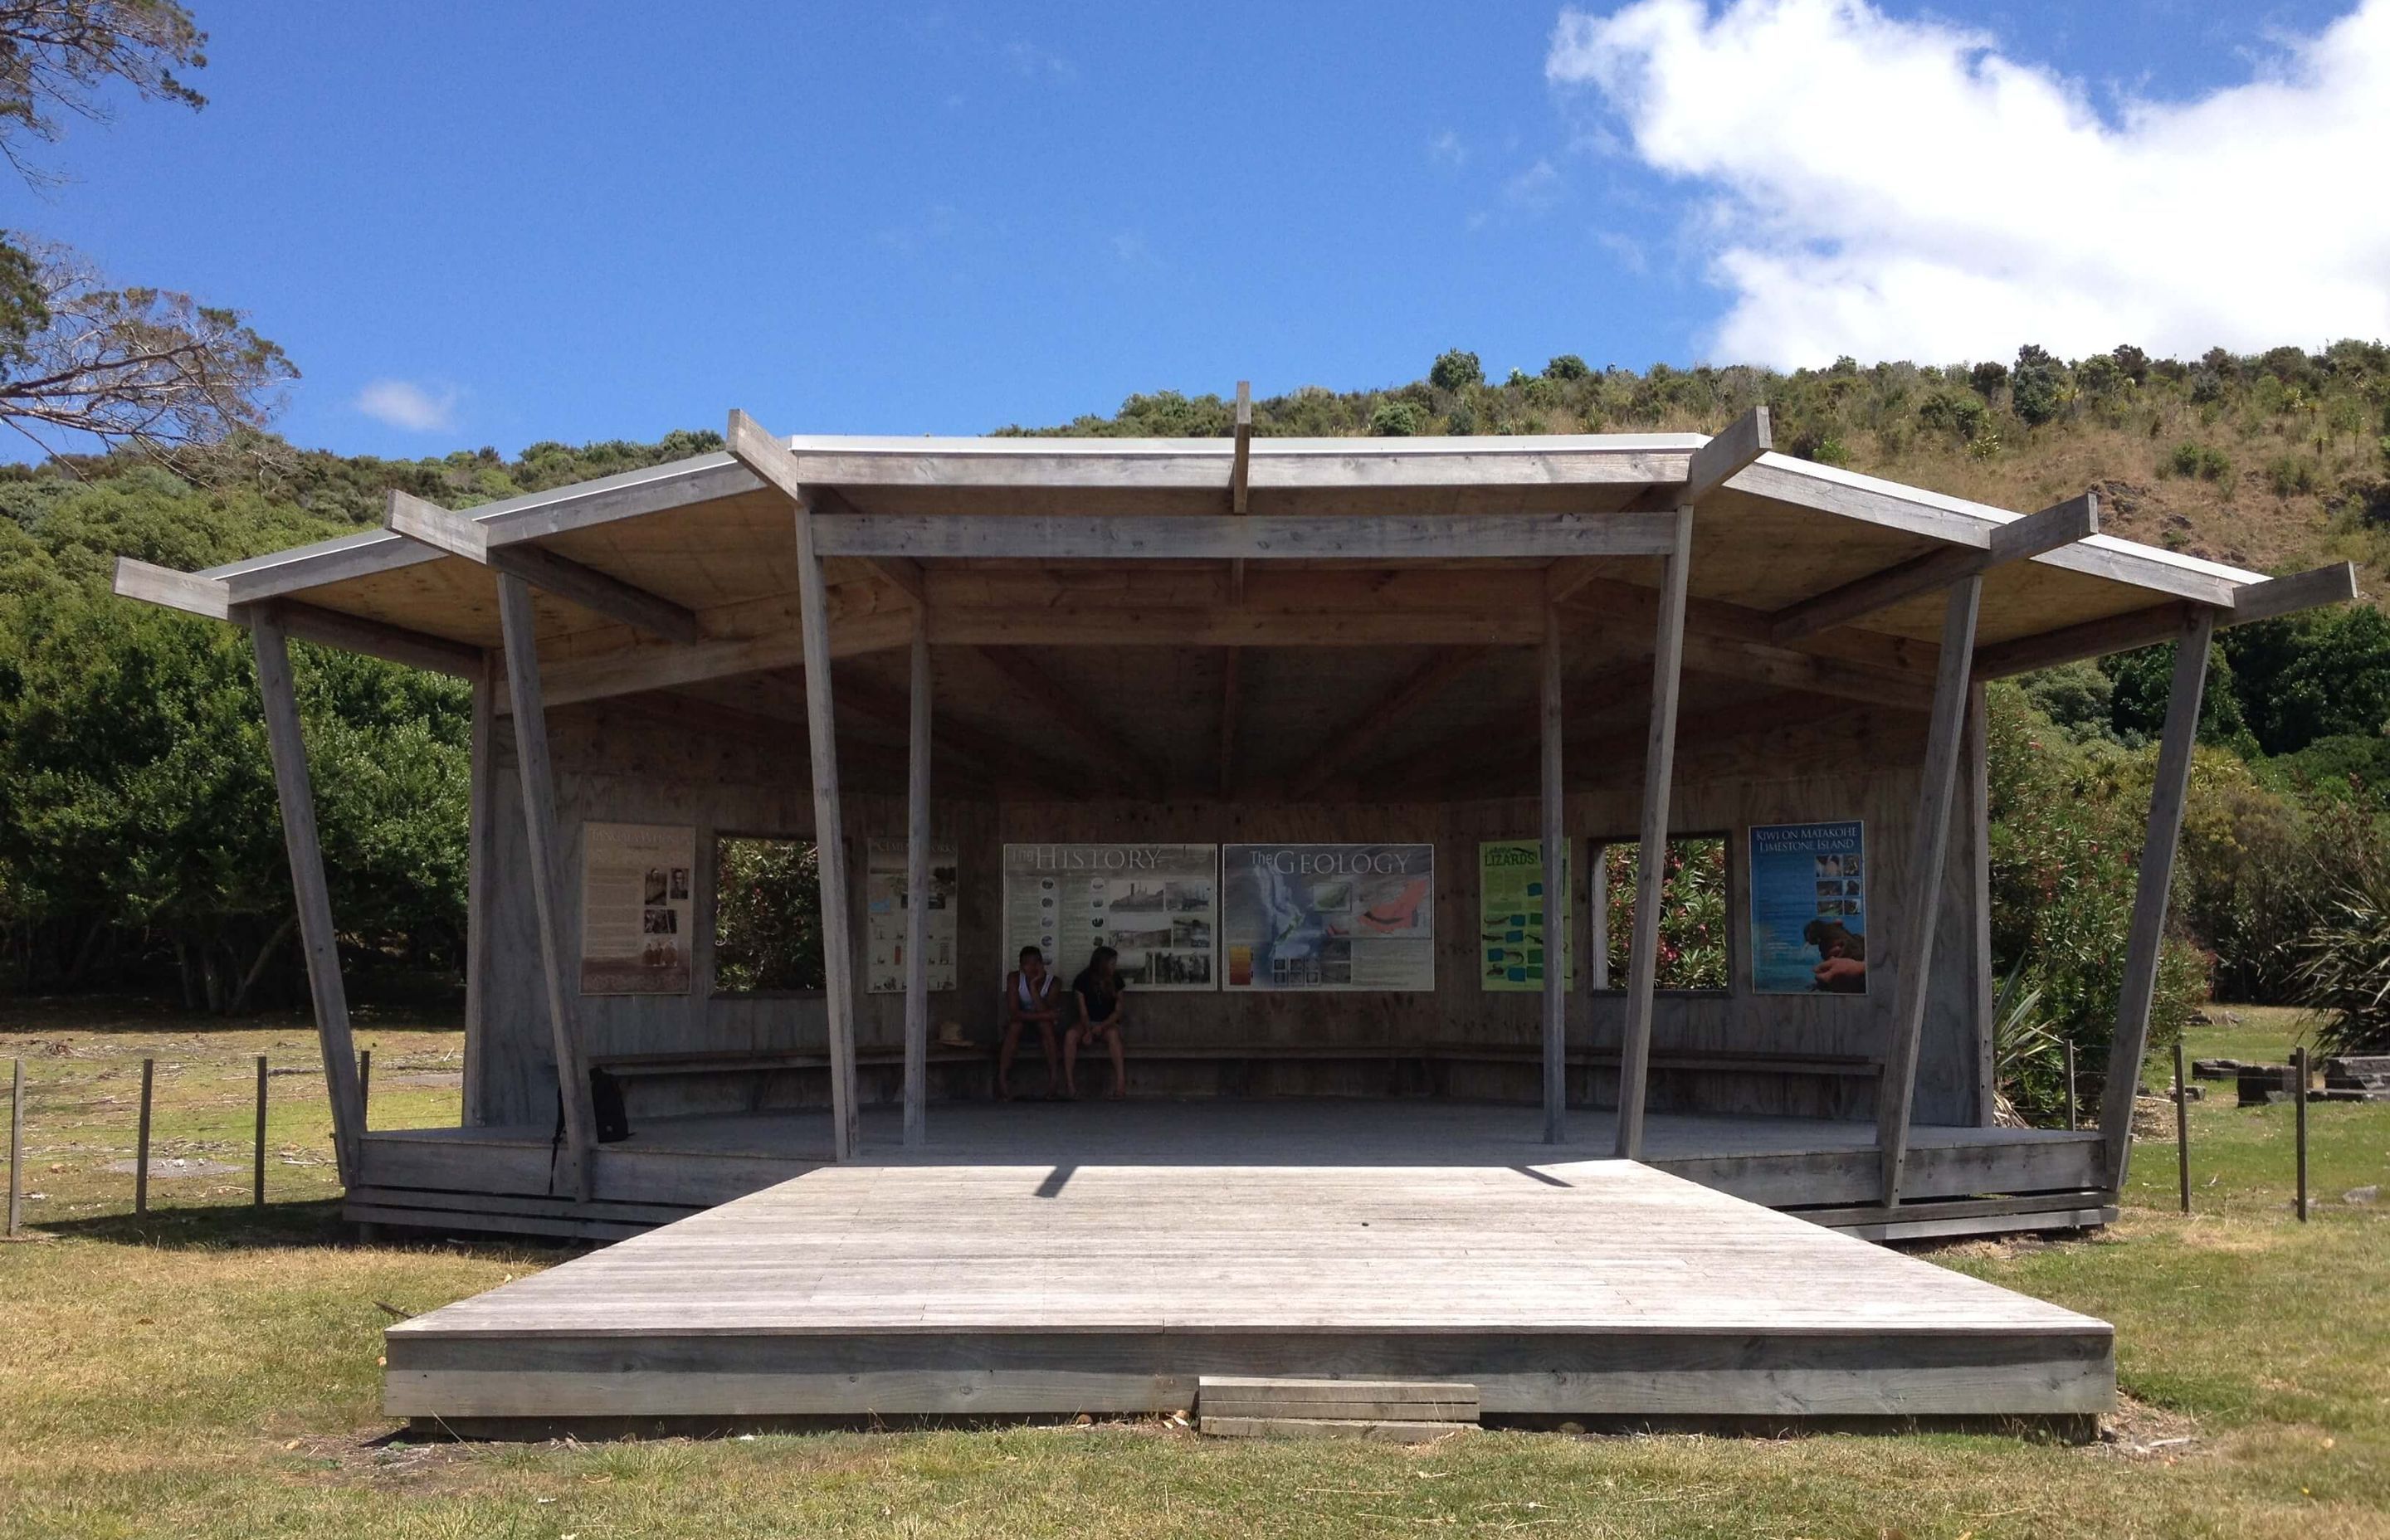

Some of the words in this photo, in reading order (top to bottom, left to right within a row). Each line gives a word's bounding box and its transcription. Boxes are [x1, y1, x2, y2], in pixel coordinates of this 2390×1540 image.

[1757, 830, 1780, 841] KIWI
[1782, 830, 1798, 840] ON
[1801, 827, 1858, 839] MATAKOHE
[1759, 841, 1815, 852] LIMESTONE
[1817, 839, 1855, 850] ISLAND
[1036, 846, 1161, 869] HISTORY
[1250, 850, 1273, 865] The
[1274, 850, 1411, 875] GEOLOGY
